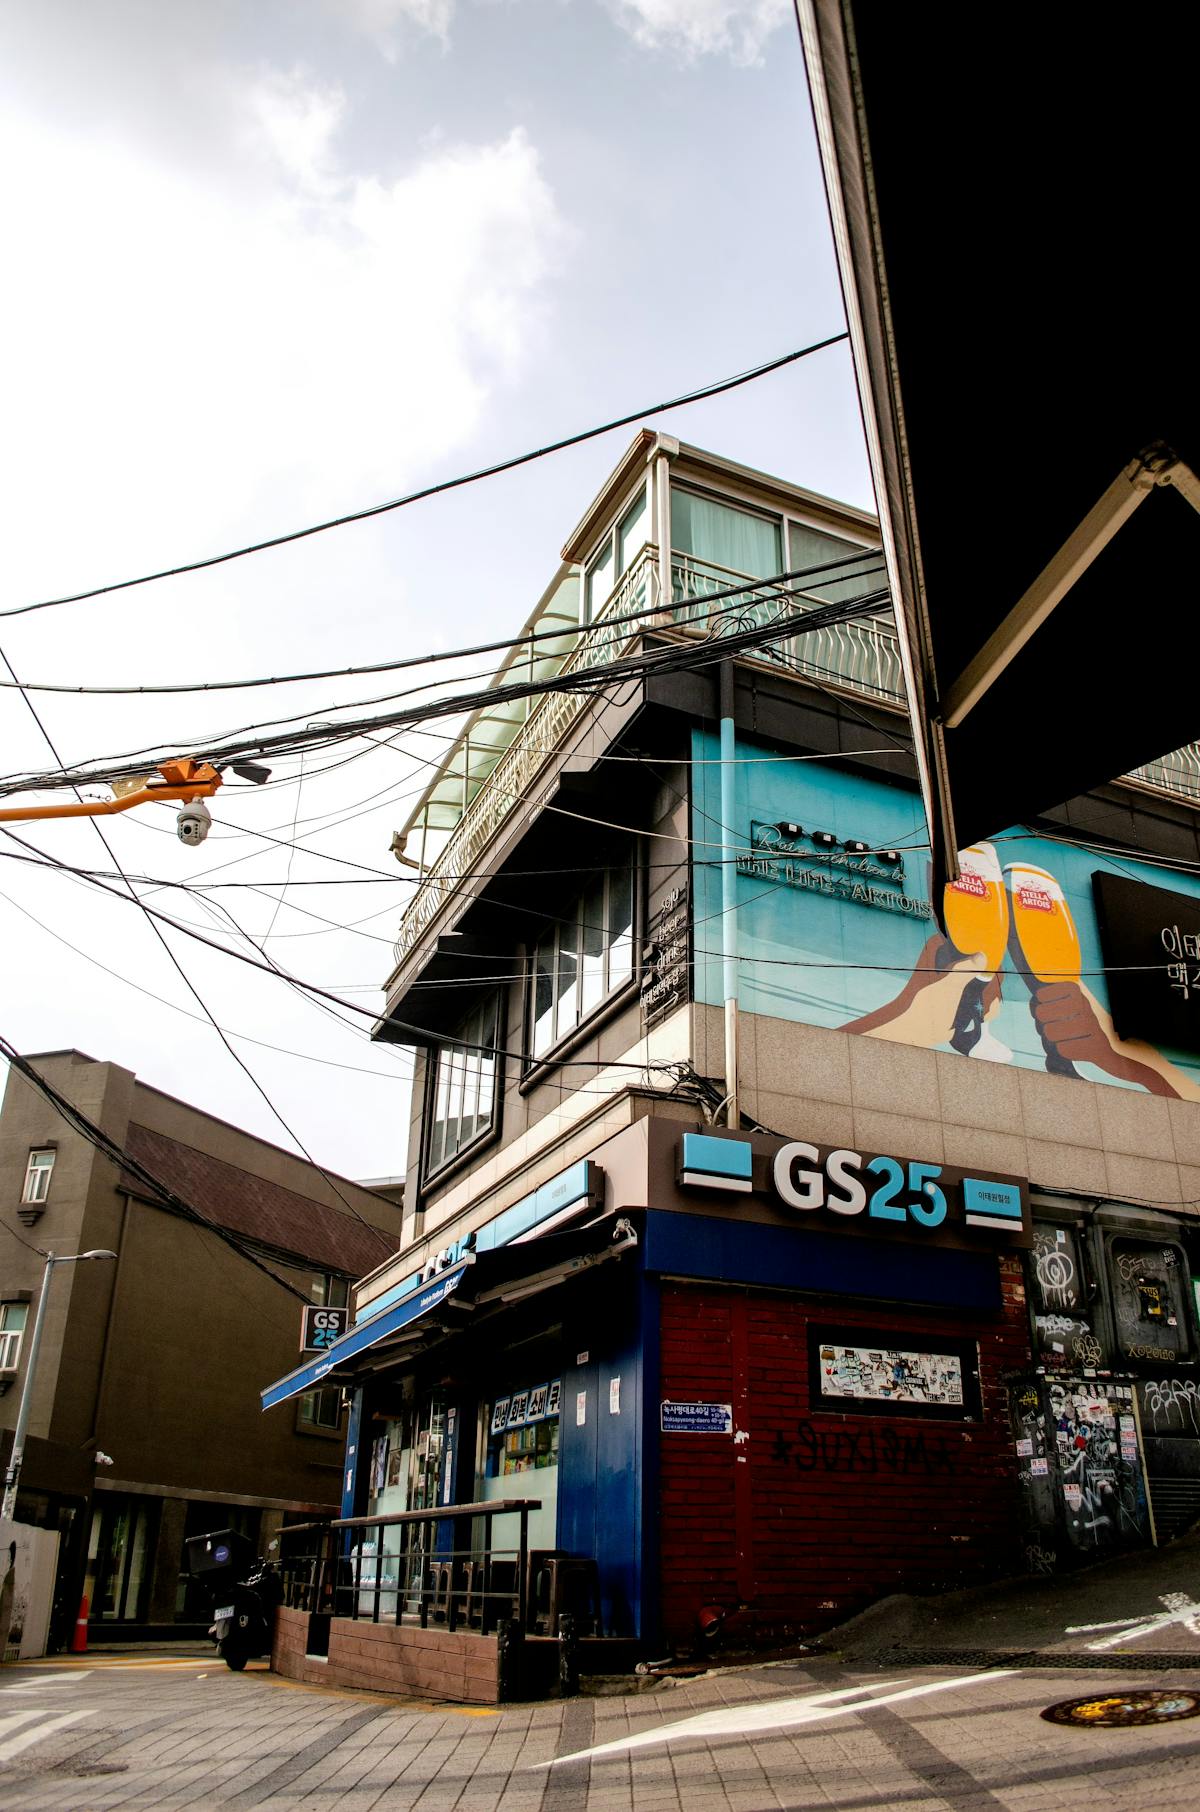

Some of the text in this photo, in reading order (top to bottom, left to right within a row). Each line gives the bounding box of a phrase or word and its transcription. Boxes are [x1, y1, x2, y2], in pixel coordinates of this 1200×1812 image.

[953, 881, 984, 895] ARTOIS
[1021, 890, 1049, 902] STELLA
[851, 883, 934, 917] ARTOIS
[1022, 897, 1051, 909] ARTOIS
[774, 1141, 948, 1227] GS25
[313, 1312, 340, 1329] GS
[313, 1329, 338, 1347] 25
[494, 1402, 510, 1429] 민생
[510, 1396, 527, 1422] 회복
[528, 1389, 547, 1417] 소비
